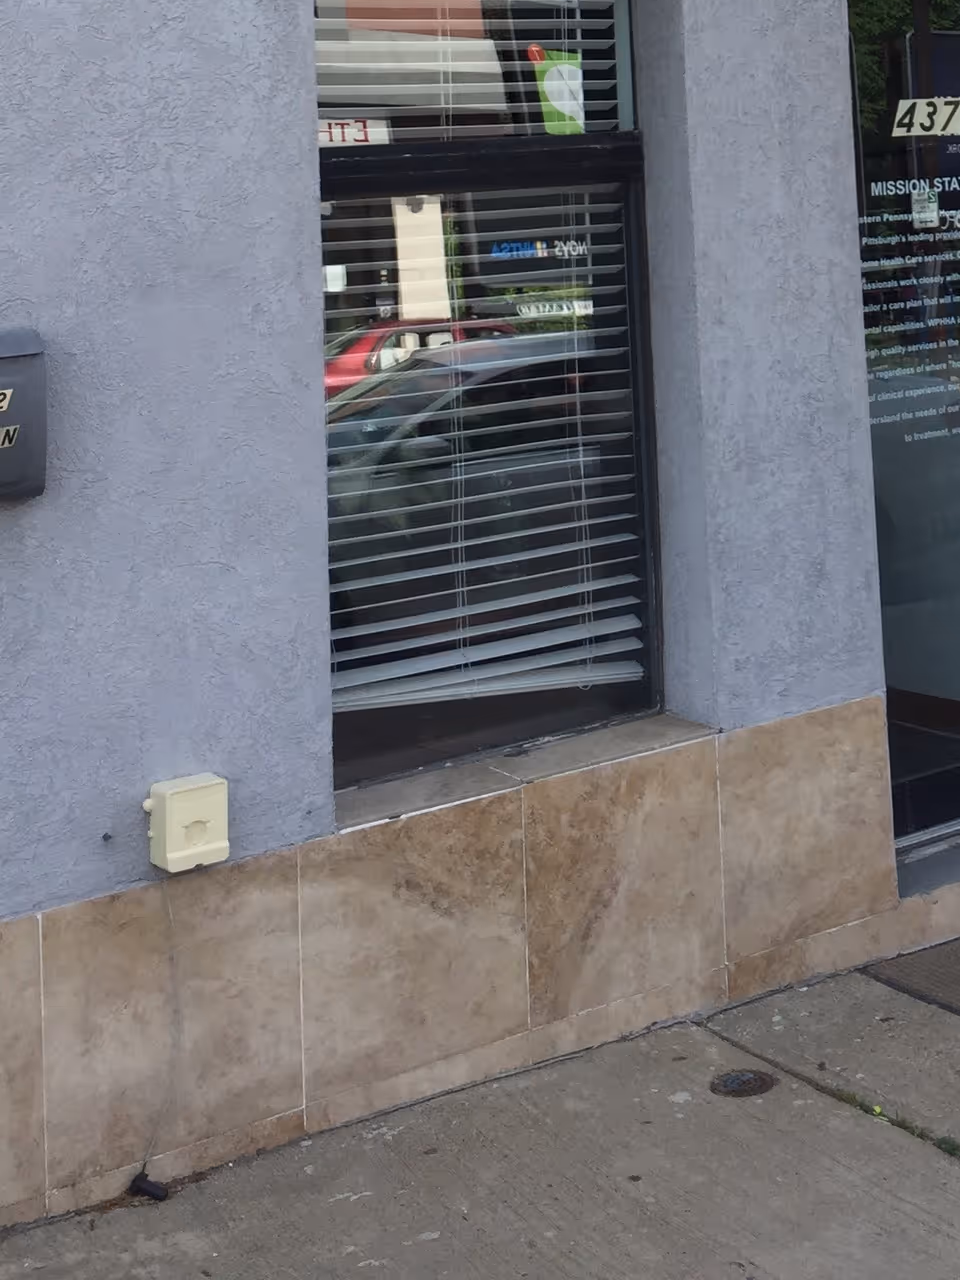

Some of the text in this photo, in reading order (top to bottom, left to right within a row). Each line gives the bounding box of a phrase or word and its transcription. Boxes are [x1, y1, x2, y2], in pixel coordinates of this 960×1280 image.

[871, 179, 930, 196] MISSION
[862, 234, 906, 246] Pittsburgh's
[907, 232, 934, 242] leading
[905, 255, 923, 264] Care
[900, 276, 918, 286] work
[919, 274, 944, 285] closely
[889, 301, 905, 309] care
[906, 299, 922, 310] plan
[923, 296, 938, 306] that
[927, 316, 956, 327] WPHHA
[881, 345, 906, 356] quality
[907, 341, 938, 352] services
[938, 340, 947, 348] in
[916, 364, 924, 373] of
[877, 389, 904, 401] clinical
[901, 412, 914, 420] the
[915, 407, 937, 417] needs
[938, 405, 946, 414] of
[947, 405, 959, 413] our
[904, 434, 912, 442] to
